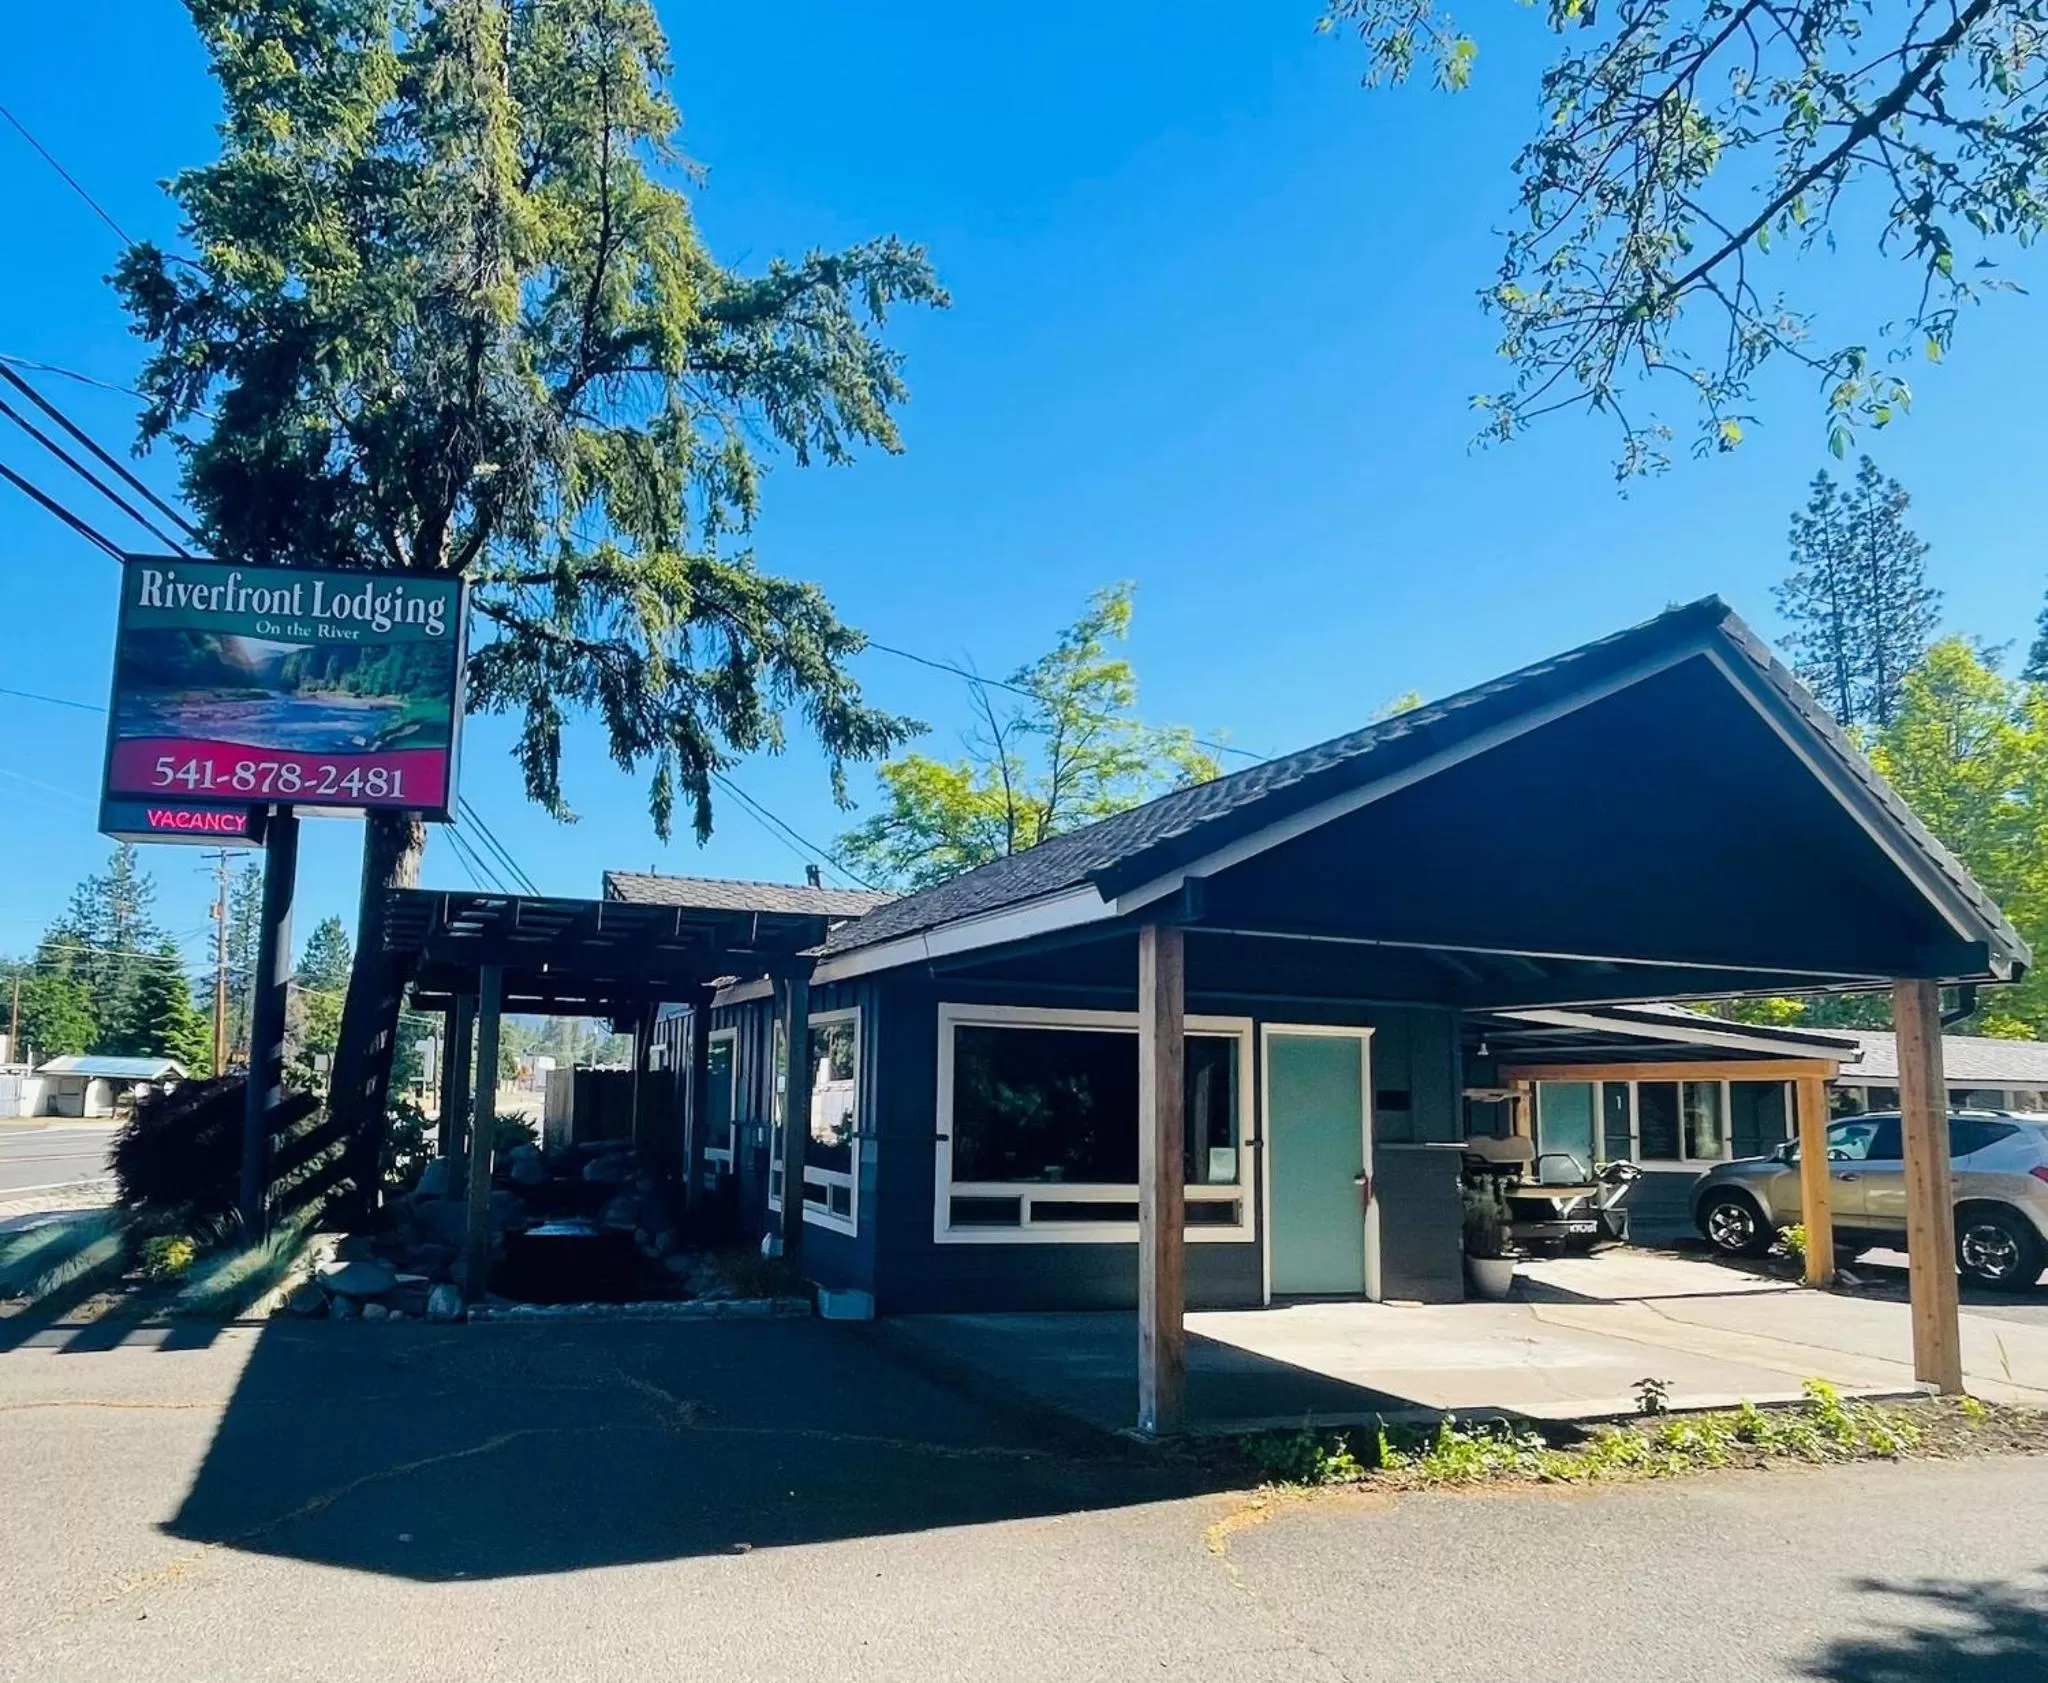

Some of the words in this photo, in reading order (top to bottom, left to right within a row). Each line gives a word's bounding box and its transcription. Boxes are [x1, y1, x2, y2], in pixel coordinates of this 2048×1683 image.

[139, 569, 303, 616] Riverfront
[311, 581, 446, 636] Lodging
[256, 620, 281, 635] On
[287, 622, 312, 637] the
[318, 623, 360, 640] River
[152, 757, 404, 798] 541-878-2481
[148, 809, 247, 831] VACANCY
